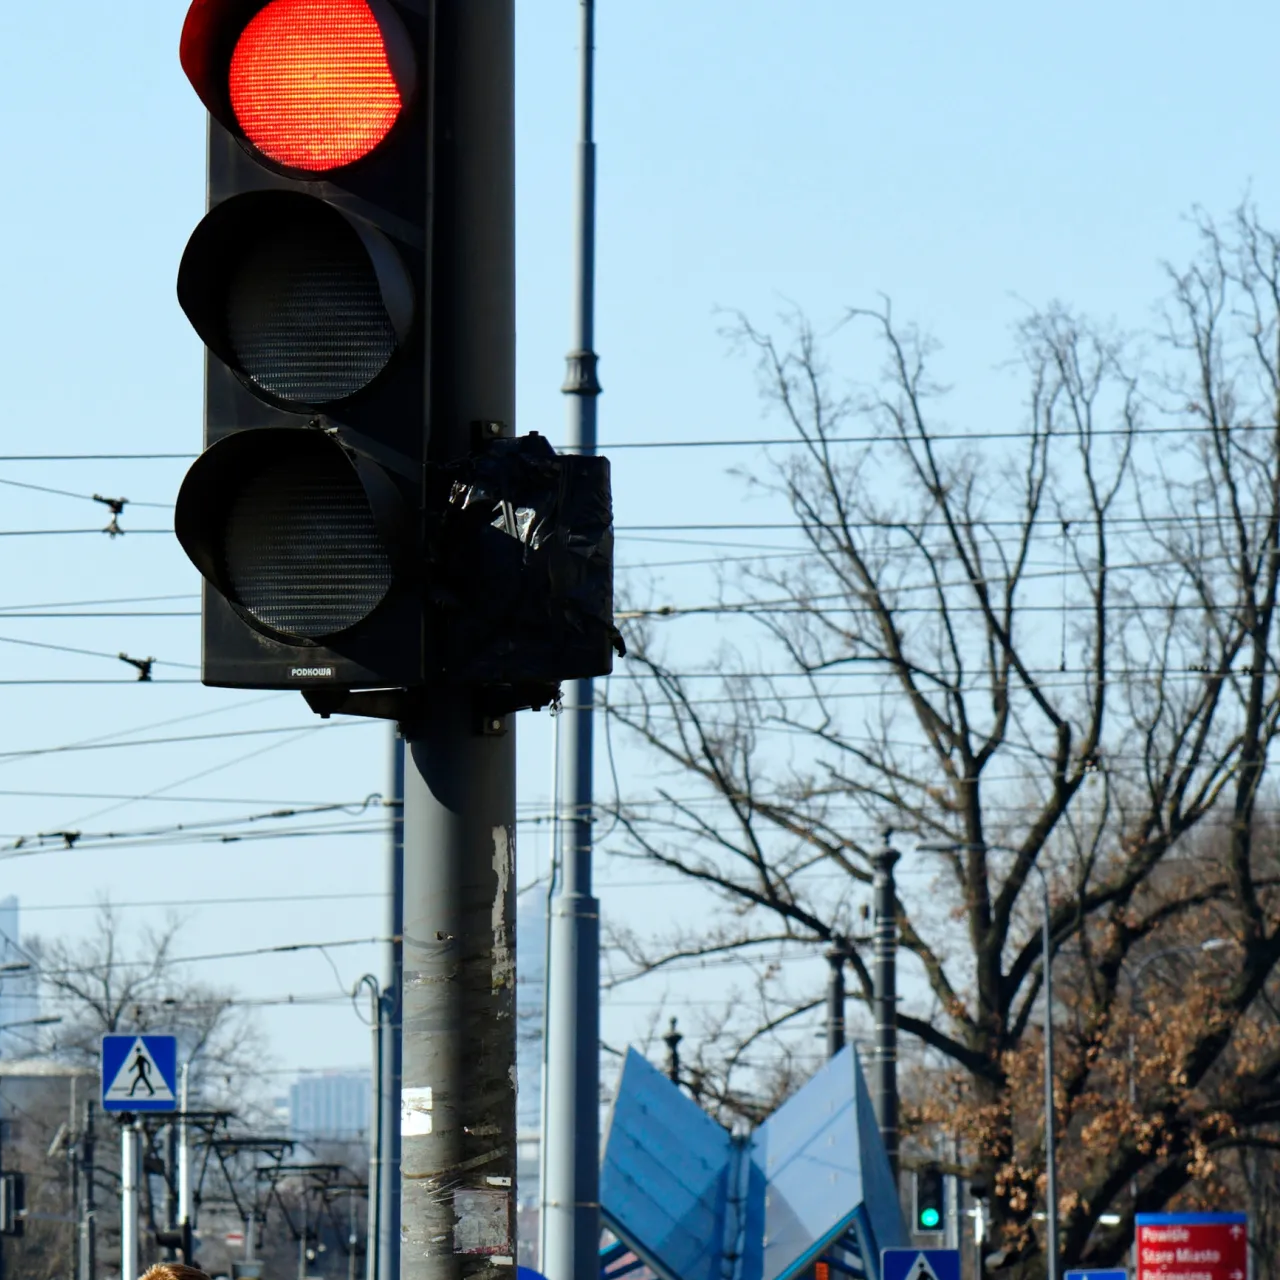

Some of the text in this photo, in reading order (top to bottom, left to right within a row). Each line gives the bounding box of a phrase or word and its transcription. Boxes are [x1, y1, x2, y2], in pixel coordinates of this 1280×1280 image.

[291, 667, 332, 677] PODKOWA
[1142, 1247, 1221, 1264] Stare Miasto
